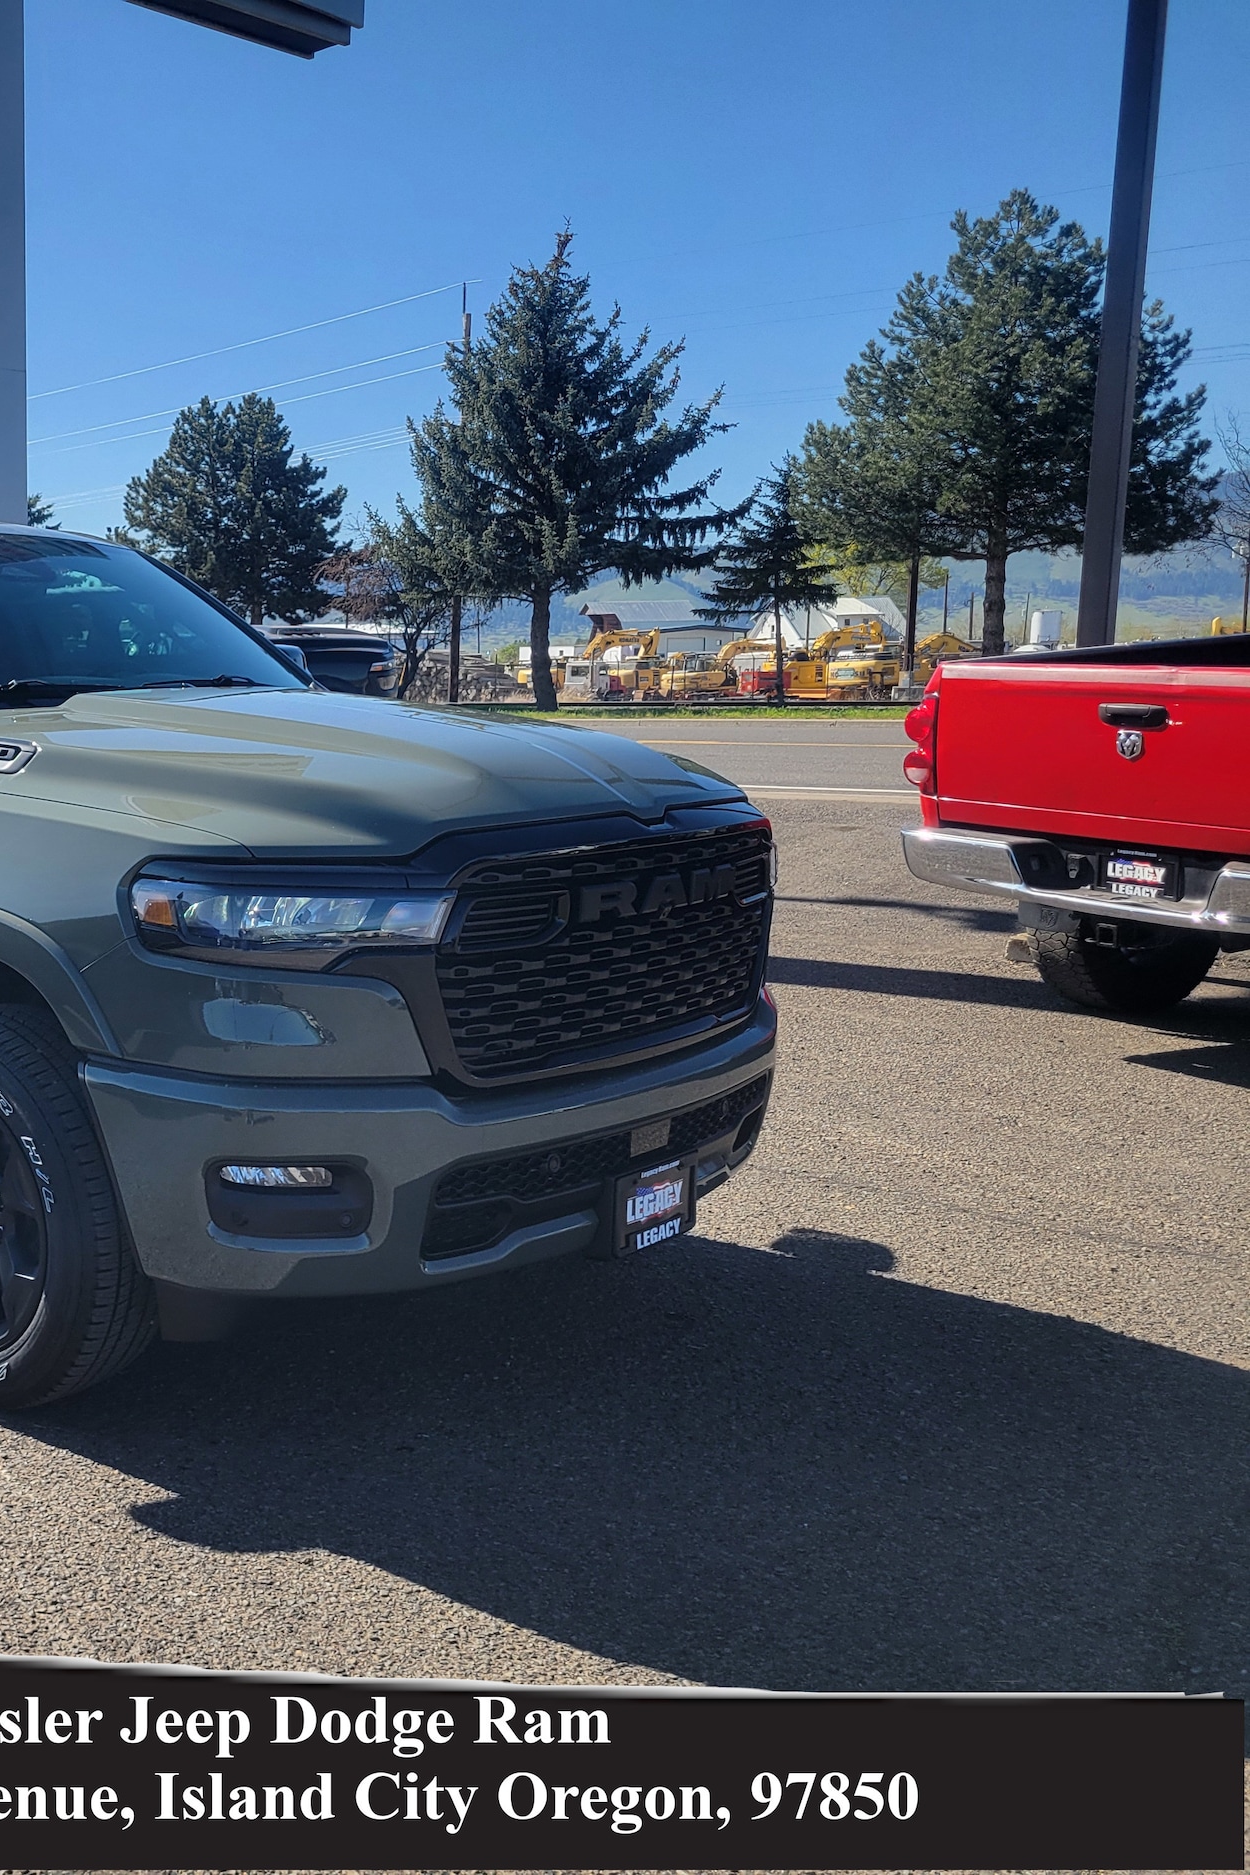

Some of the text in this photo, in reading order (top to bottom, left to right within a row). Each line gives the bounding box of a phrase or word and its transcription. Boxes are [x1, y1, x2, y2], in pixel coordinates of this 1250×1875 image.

[1106, 861, 1167, 884] LEGACY
[580, 863, 738, 922] RAM
[1111, 883, 1158, 898] LEGACY
[626, 1180, 684, 1224] LEGACY
[636, 1217, 682, 1250] LEGACY
